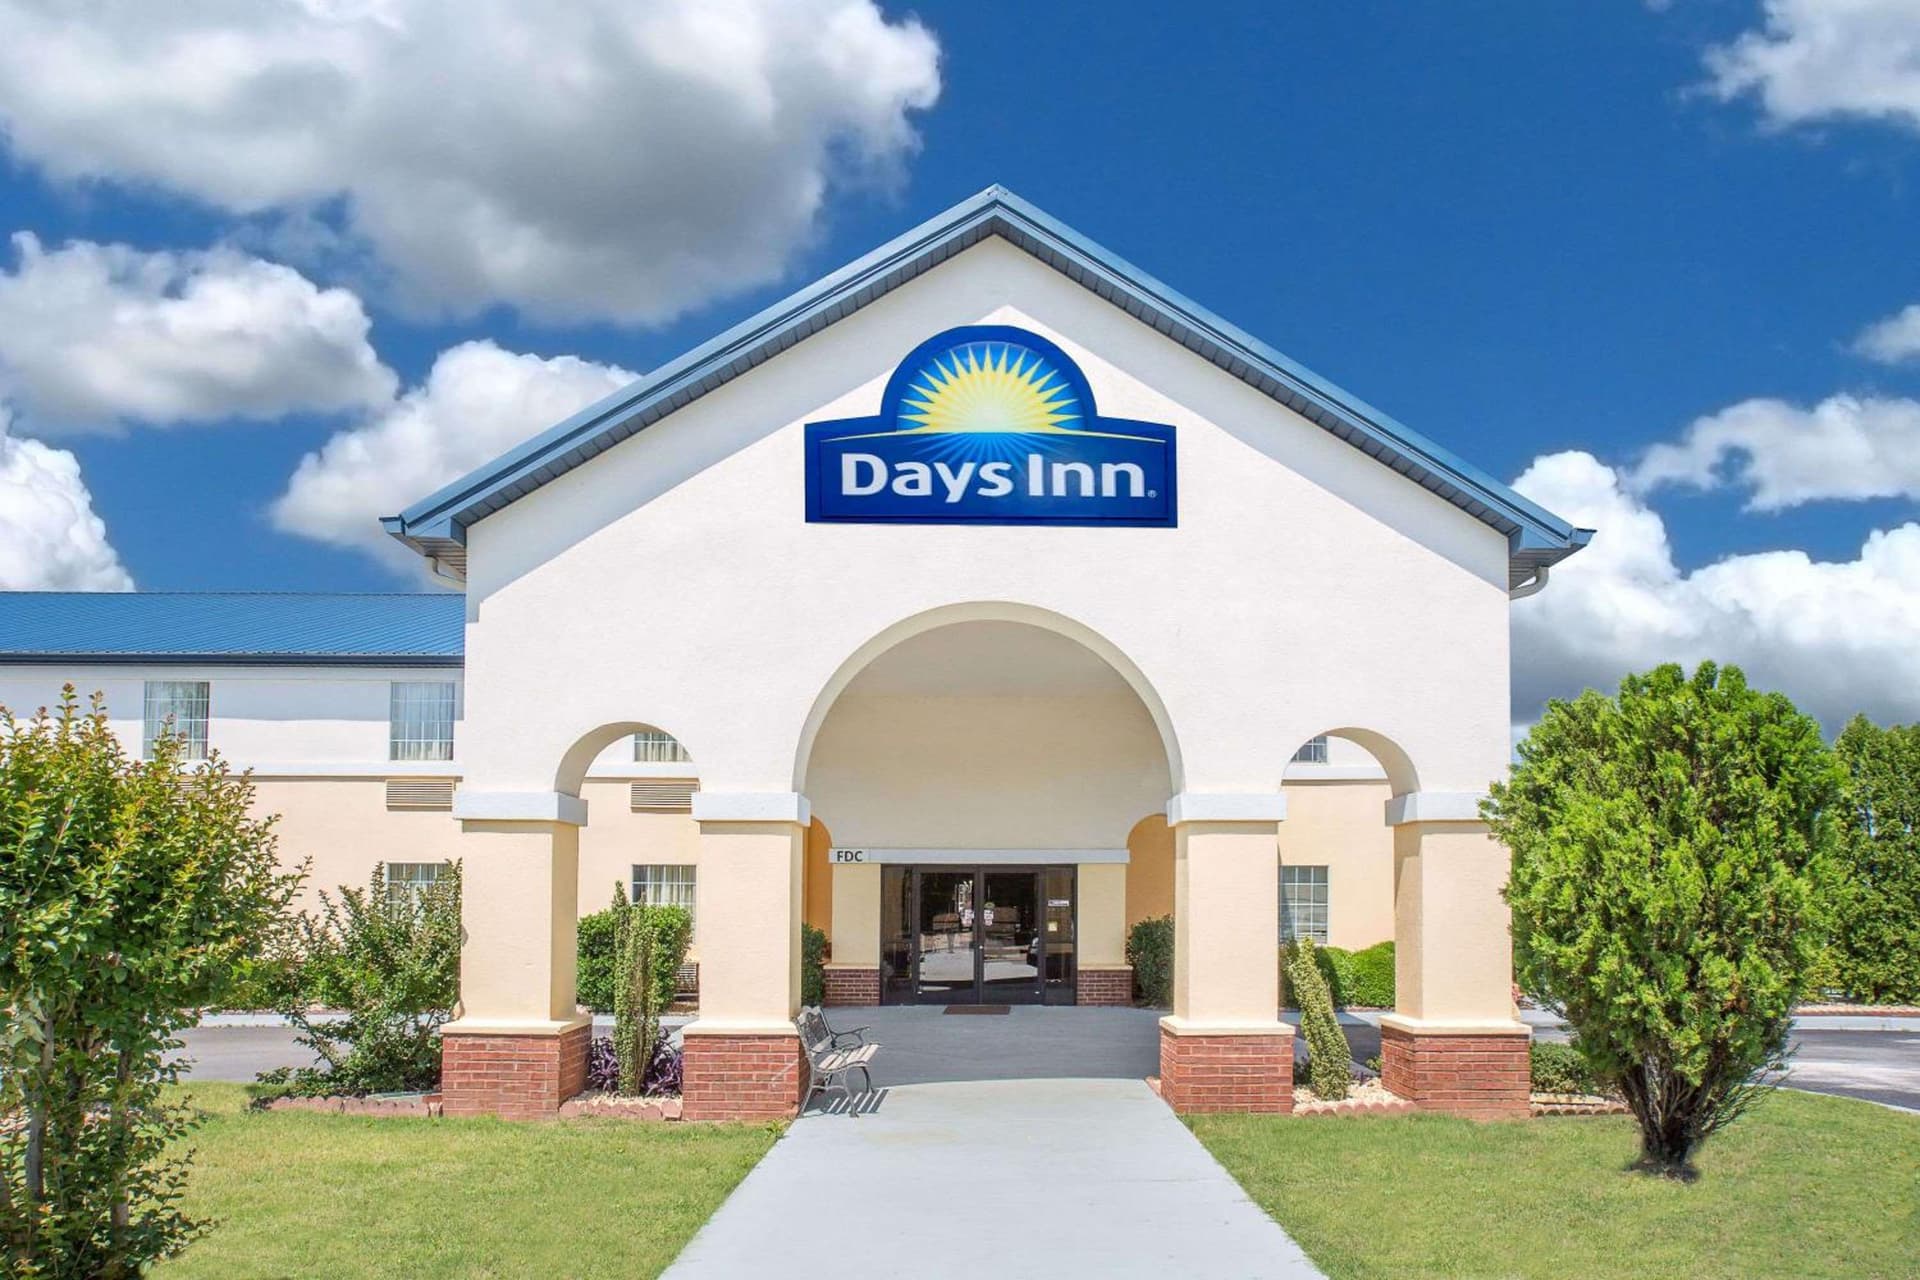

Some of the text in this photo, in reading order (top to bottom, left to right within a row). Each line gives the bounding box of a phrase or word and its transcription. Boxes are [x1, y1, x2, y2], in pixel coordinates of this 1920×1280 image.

[841, 453, 1145, 503] Days Inn
[837, 850, 863, 862] FDC
